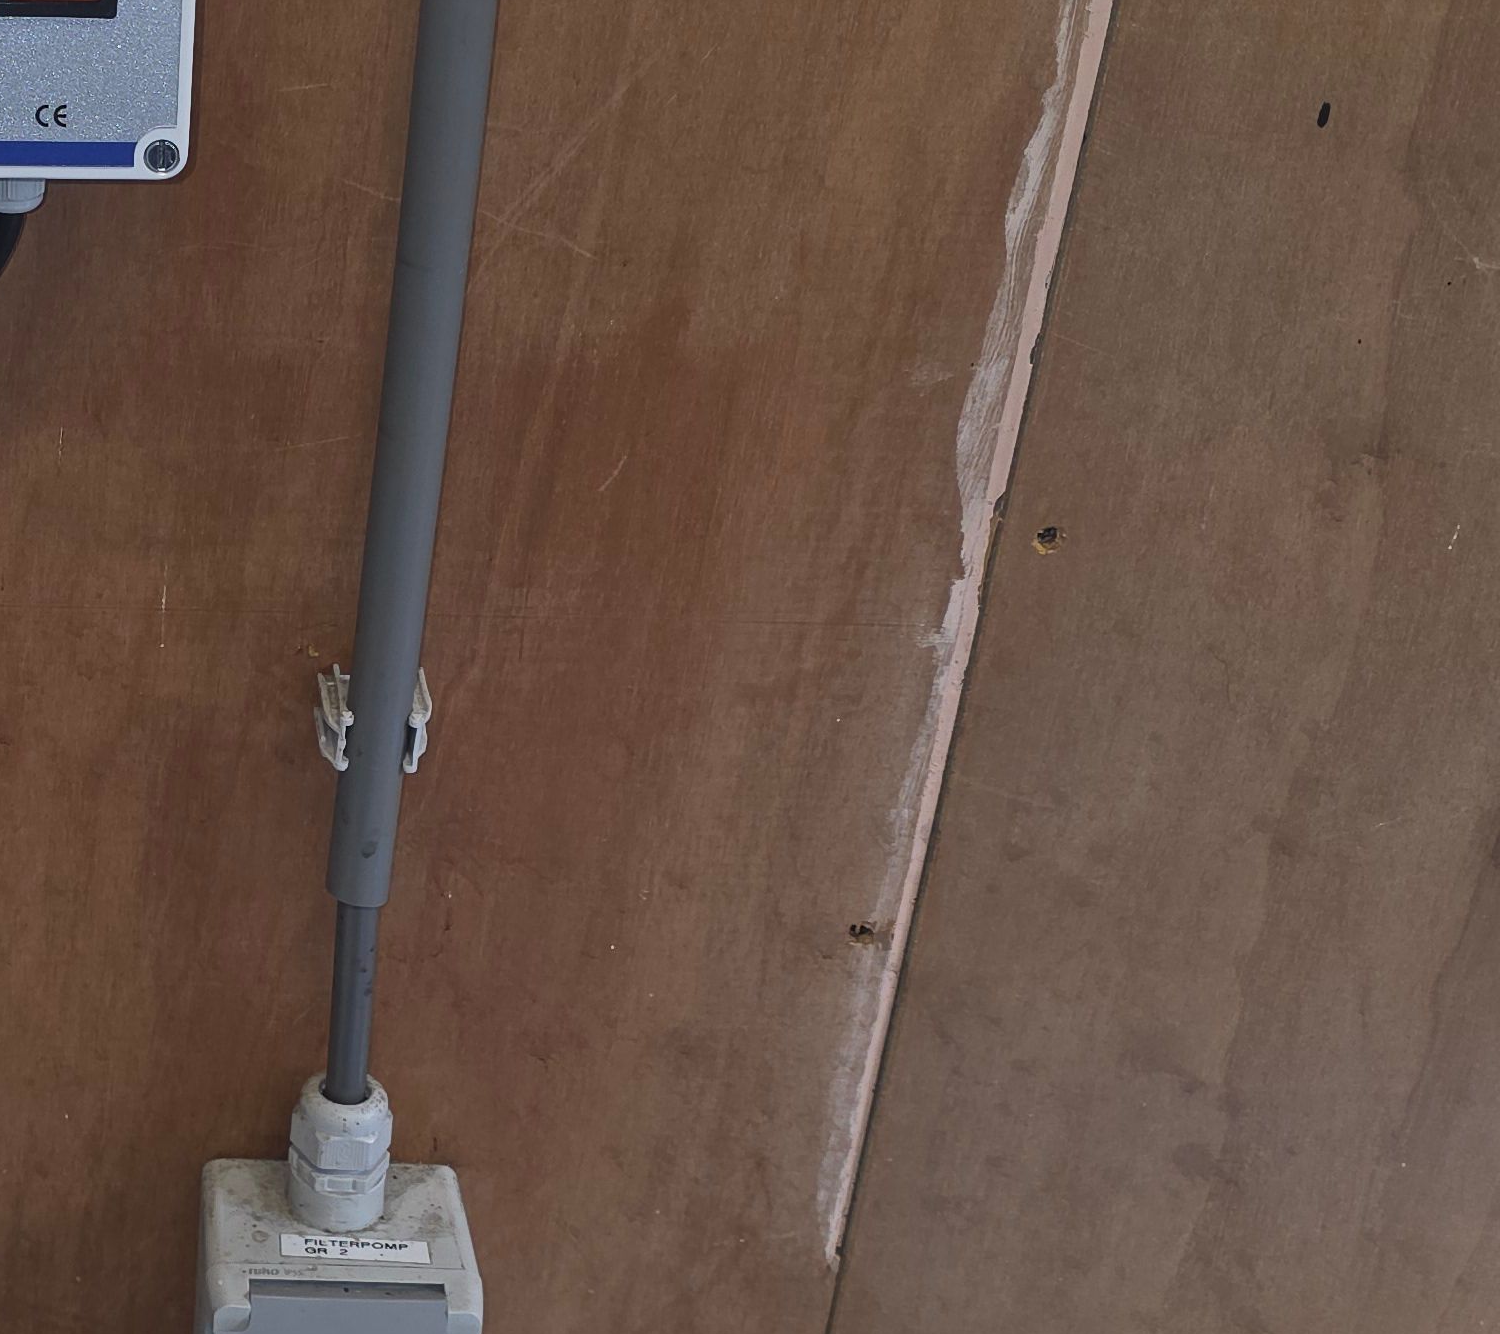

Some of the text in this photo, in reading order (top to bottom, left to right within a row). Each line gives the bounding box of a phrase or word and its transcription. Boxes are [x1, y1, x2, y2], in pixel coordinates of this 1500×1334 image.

[304, 1238, 409, 1251] FILTERPOMP
[304, 1246, 349, 1256] GR 2
